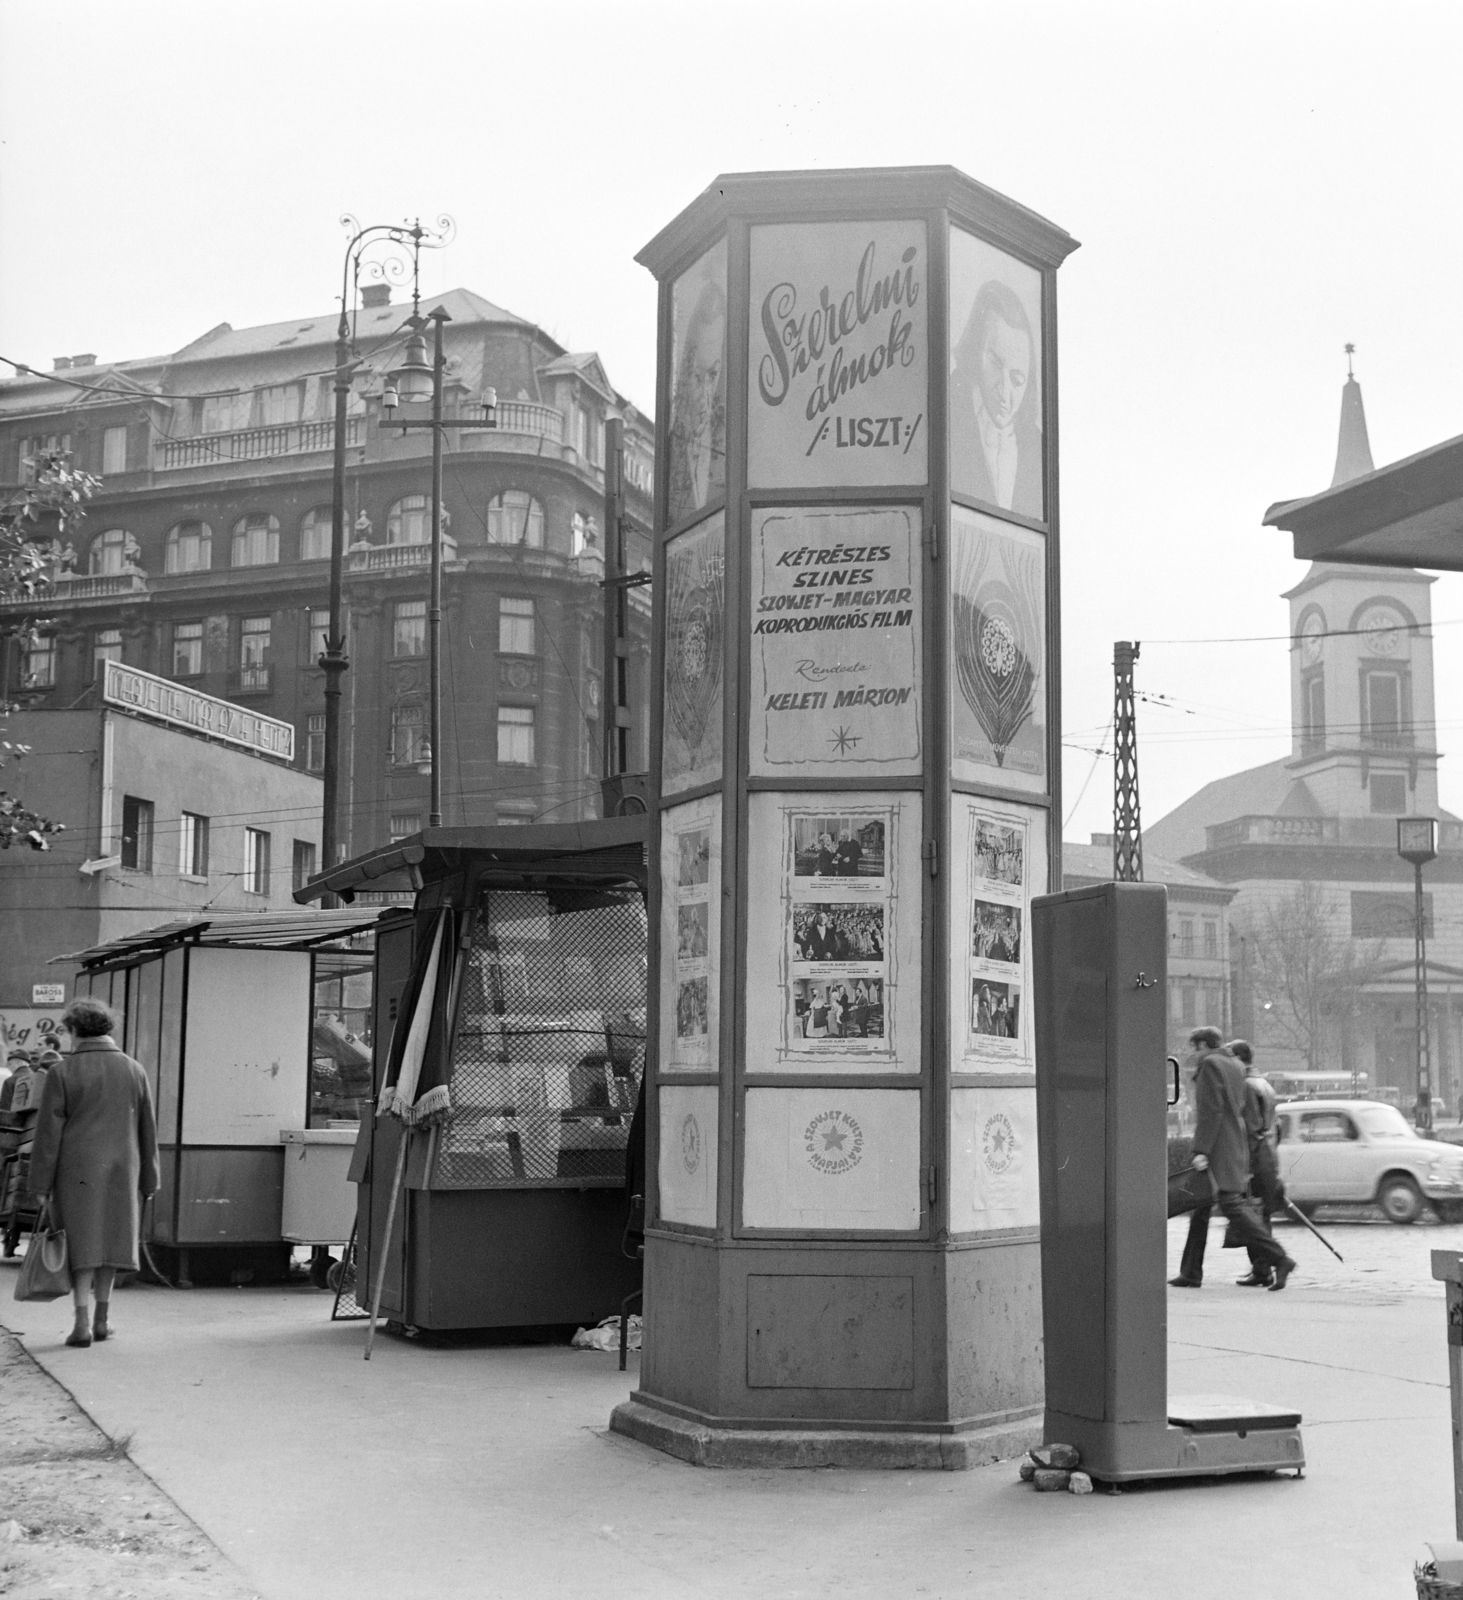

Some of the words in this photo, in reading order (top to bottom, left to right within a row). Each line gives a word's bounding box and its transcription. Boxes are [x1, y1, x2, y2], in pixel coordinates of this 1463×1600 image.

[758, 240, 919, 407] Szerelmi
[805, 308, 915, 421] álmok
[775, 543, 892, 567] KÉTRÉSZES
[792, 568, 875, 588] SZINES
[756, 587, 912, 613] SZOVJET-MAGYAR
[753, 608, 869, 635] KOPRODUKCIÓS
[869, 609, 913, 629] FILM
[764, 690, 828, 711] KELETI
[832, 684, 912, 709] MÁRTON
[804, 1110, 842, 1141] SZOVJET
[841, 1113, 865, 1160] KULTÚRA
[810, 1153, 849, 1170] NAPJAI
